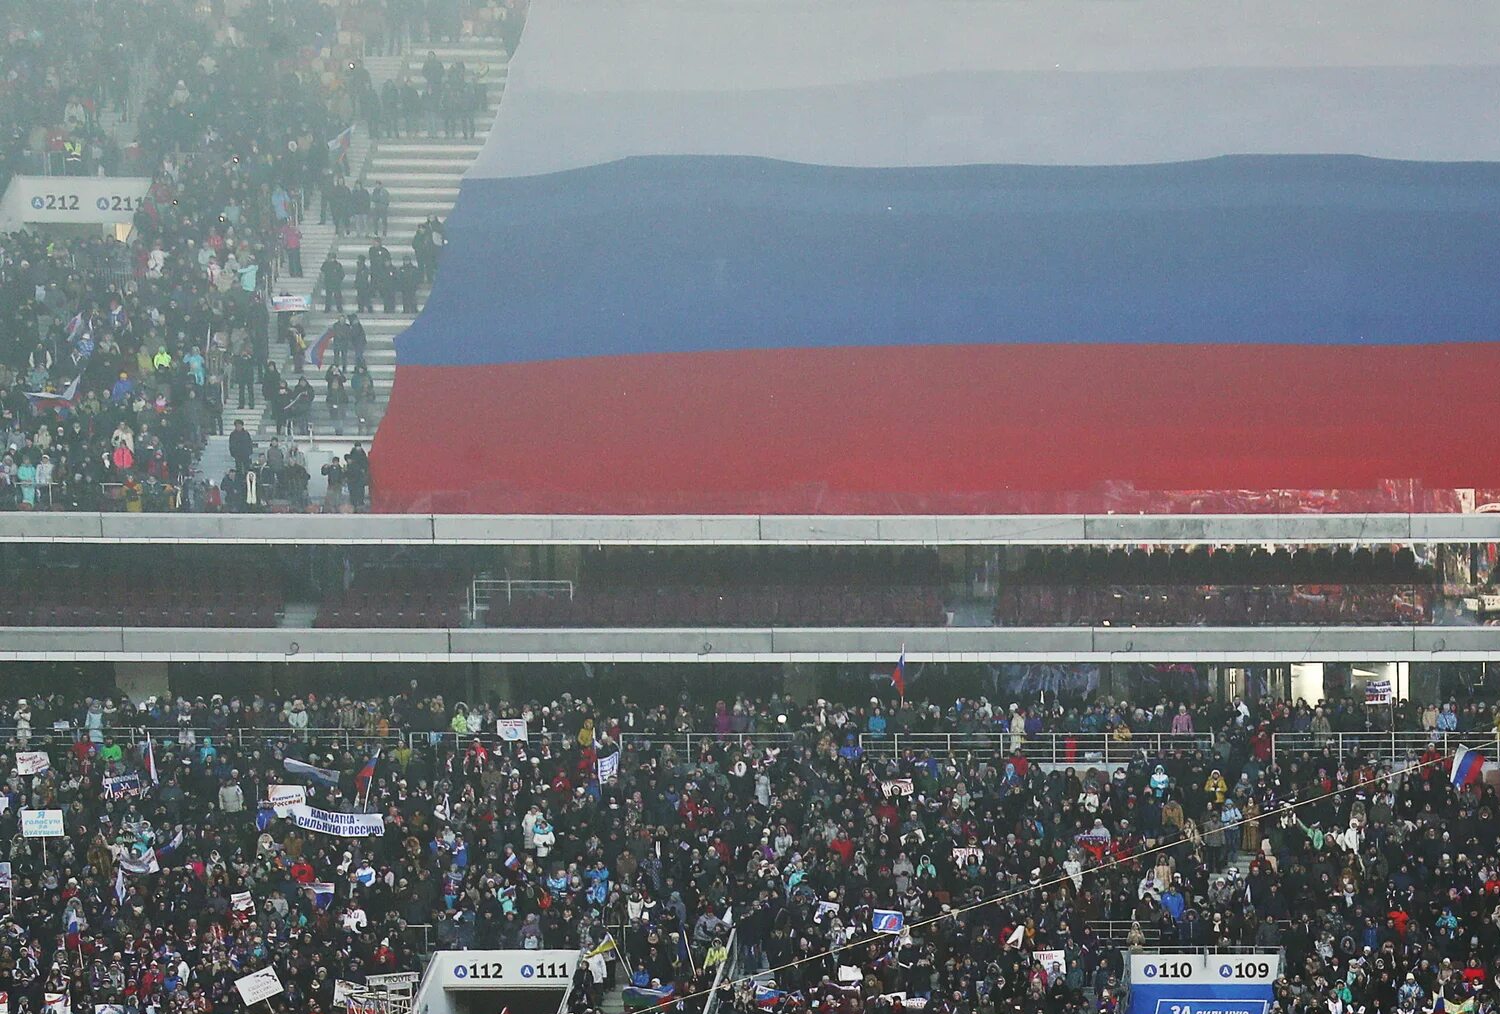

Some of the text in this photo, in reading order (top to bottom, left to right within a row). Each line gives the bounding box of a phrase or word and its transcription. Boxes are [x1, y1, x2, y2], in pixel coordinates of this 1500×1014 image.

[46, 195, 79, 210] 212
[310, 808, 355, 825] КАМЧАТКА
[298, 816, 341, 834] СИЛЬНУЮ
[342, 825, 383, 836] РОССИЮ!
[470, 963, 502, 978] 112
[537, 963, 568, 978] 111
[1159, 962, 1192, 978] 110
[1235, 962, 1269, 978] 109
